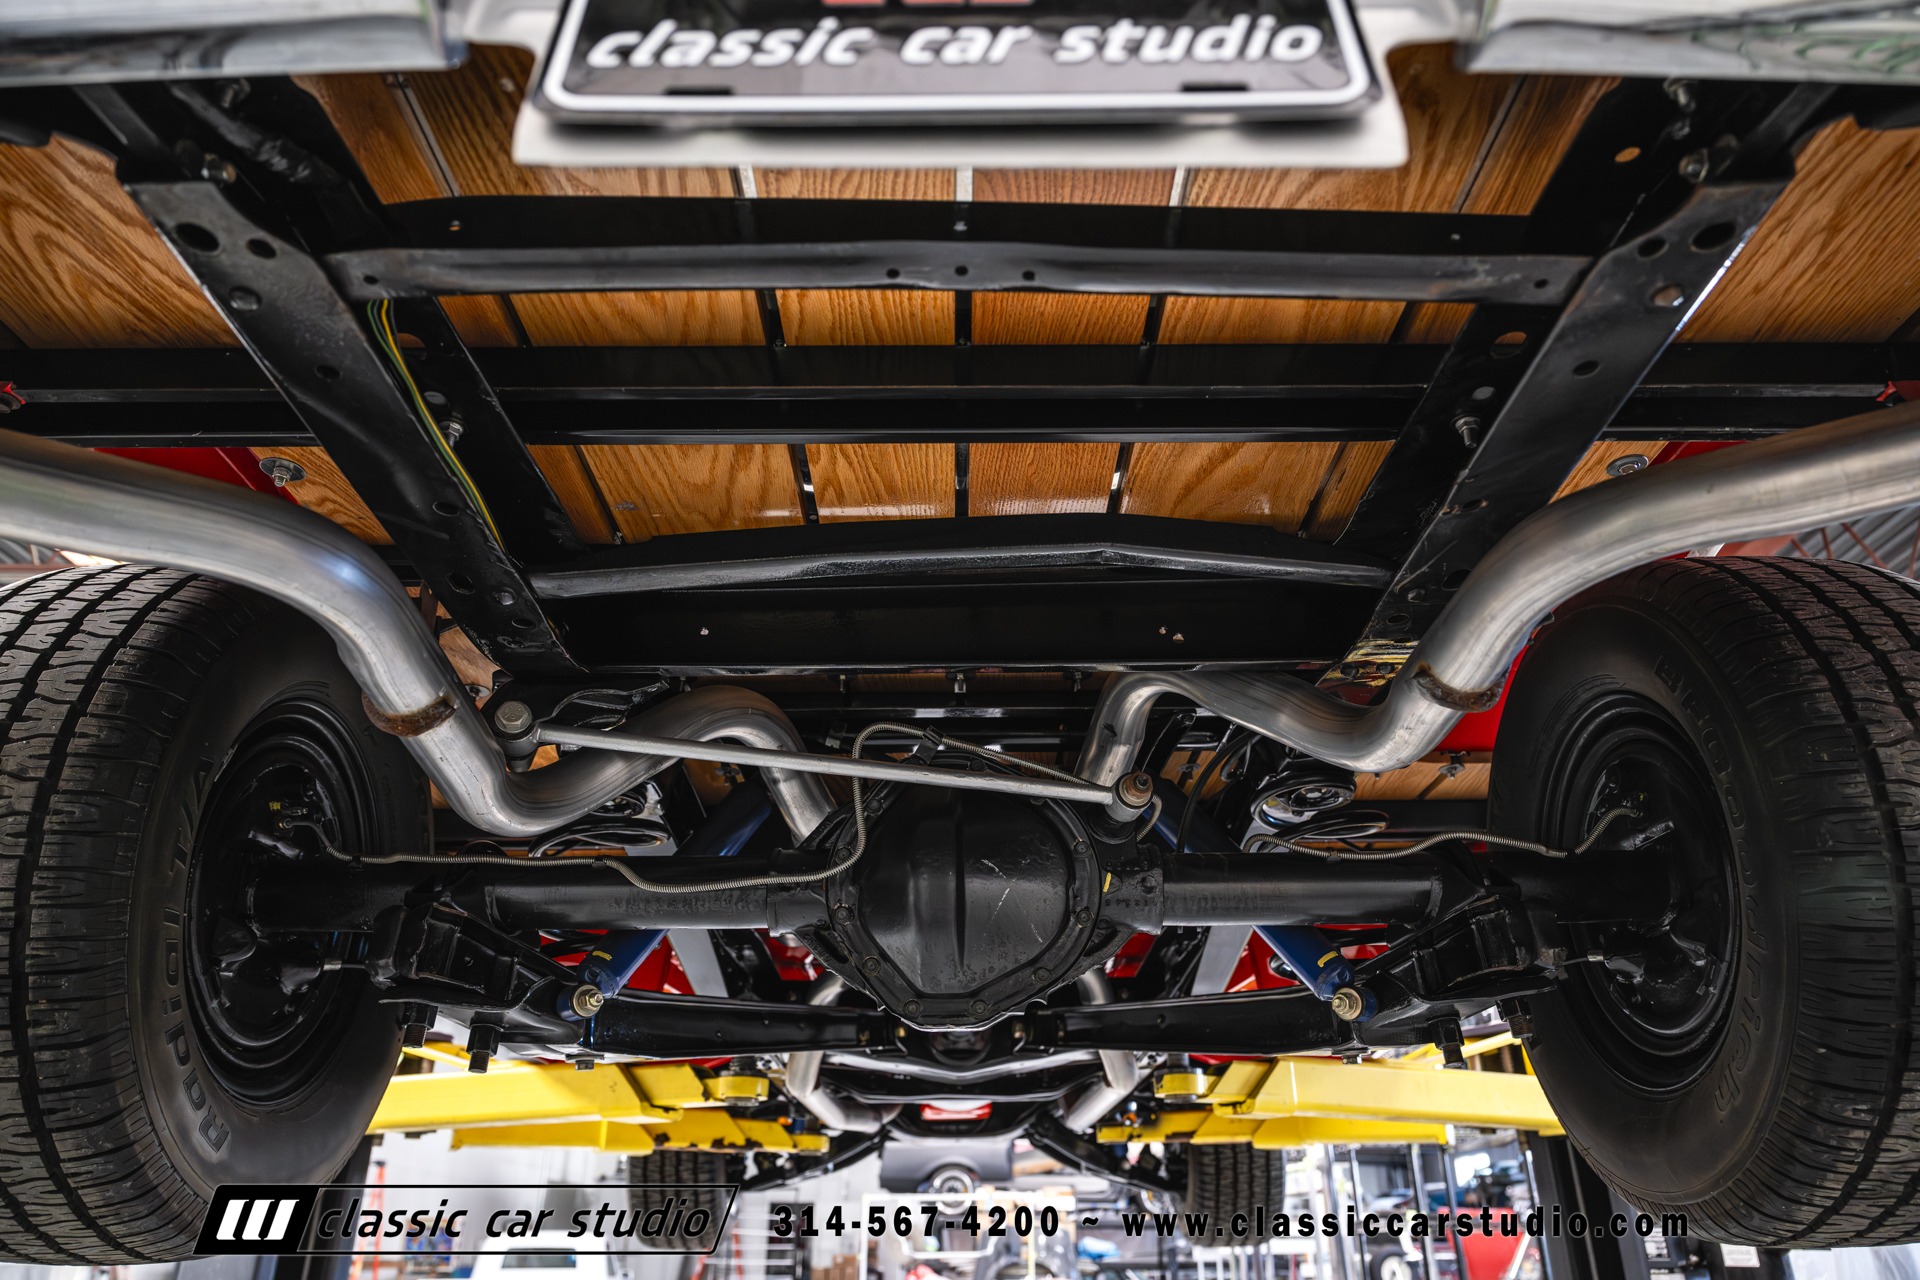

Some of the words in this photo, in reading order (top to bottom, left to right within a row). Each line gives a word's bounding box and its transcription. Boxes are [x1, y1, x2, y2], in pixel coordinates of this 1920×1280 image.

[588, 20, 873, 68] classic
[901, 25, 1034, 66] car
[1055, 14, 1322, 65] studio
[162, 907, 230, 1152] Radial
